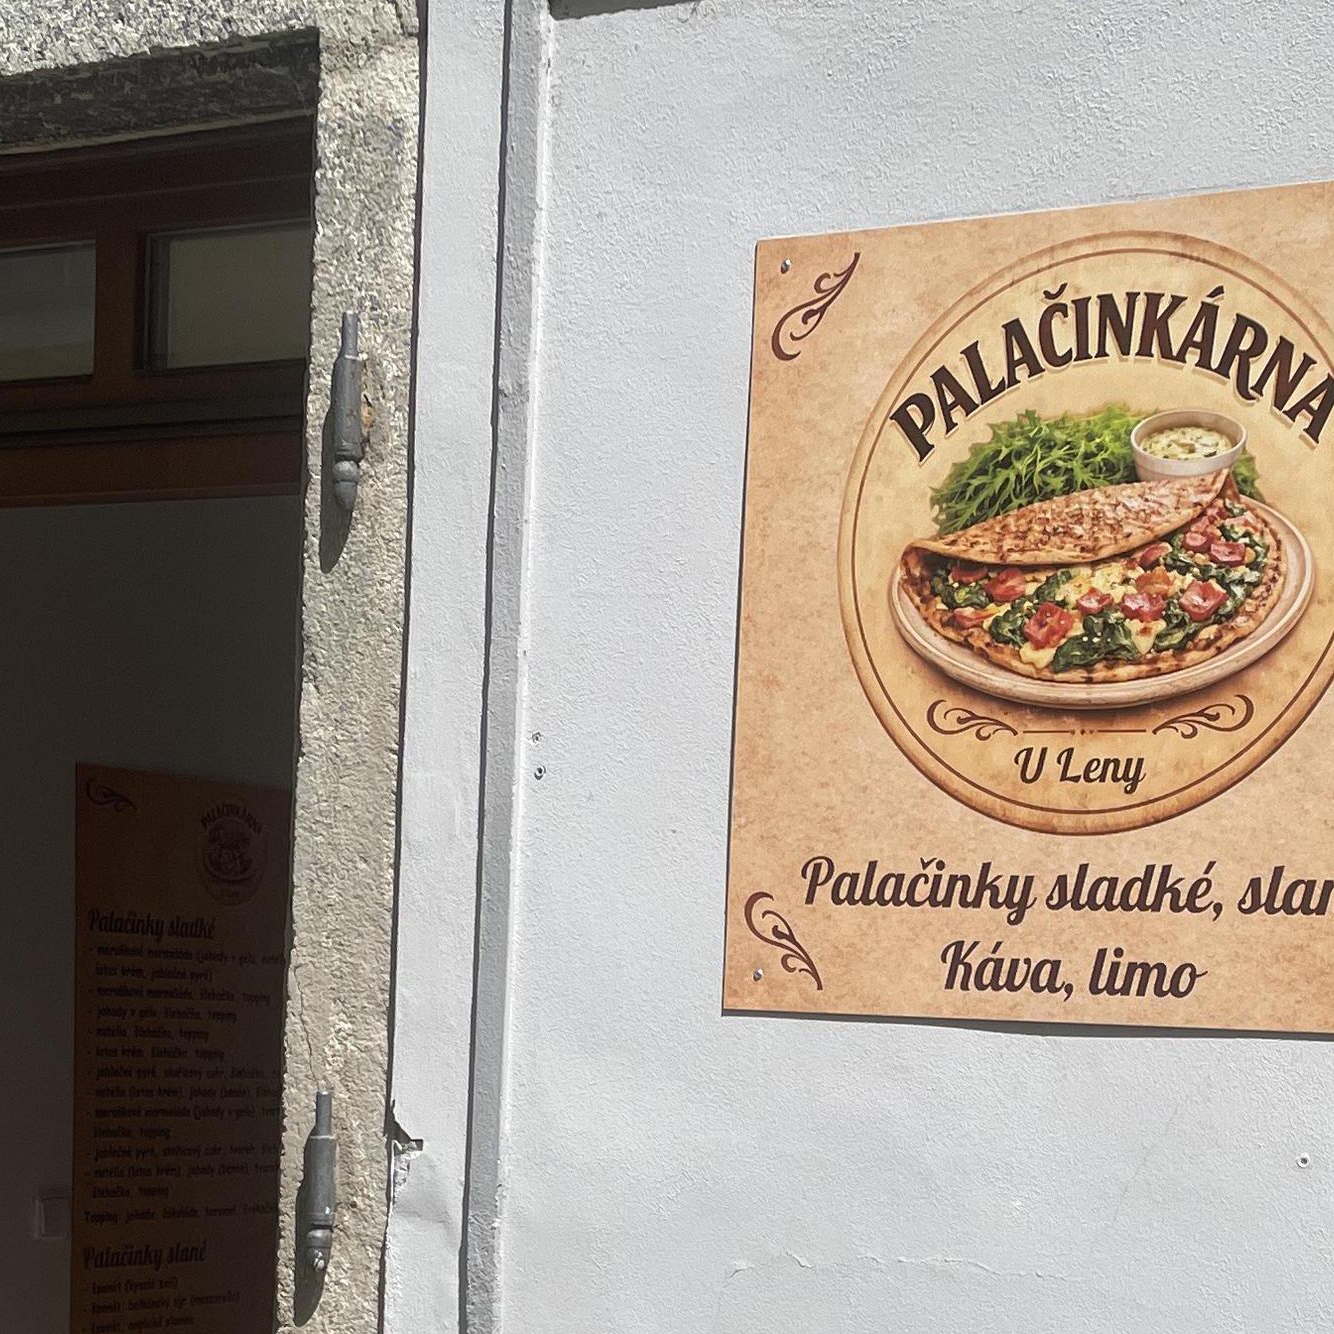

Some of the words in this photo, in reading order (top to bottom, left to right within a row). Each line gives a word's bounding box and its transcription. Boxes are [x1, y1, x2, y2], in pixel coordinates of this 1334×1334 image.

[1014, 746, 1048, 784] U
[1056, 747, 1146, 794] Leny
[800, 855, 1037, 926] Palačinky
[1045, 860, 1224, 921] sladké,
[89, 908, 164, 943] Palačinky
[168, 915, 215, 939] sladké
[940, 939, 1074, 1001] Káva,
[1088, 947, 1210, 998] limo
[83, 1244, 163, 1271] Palačinky
